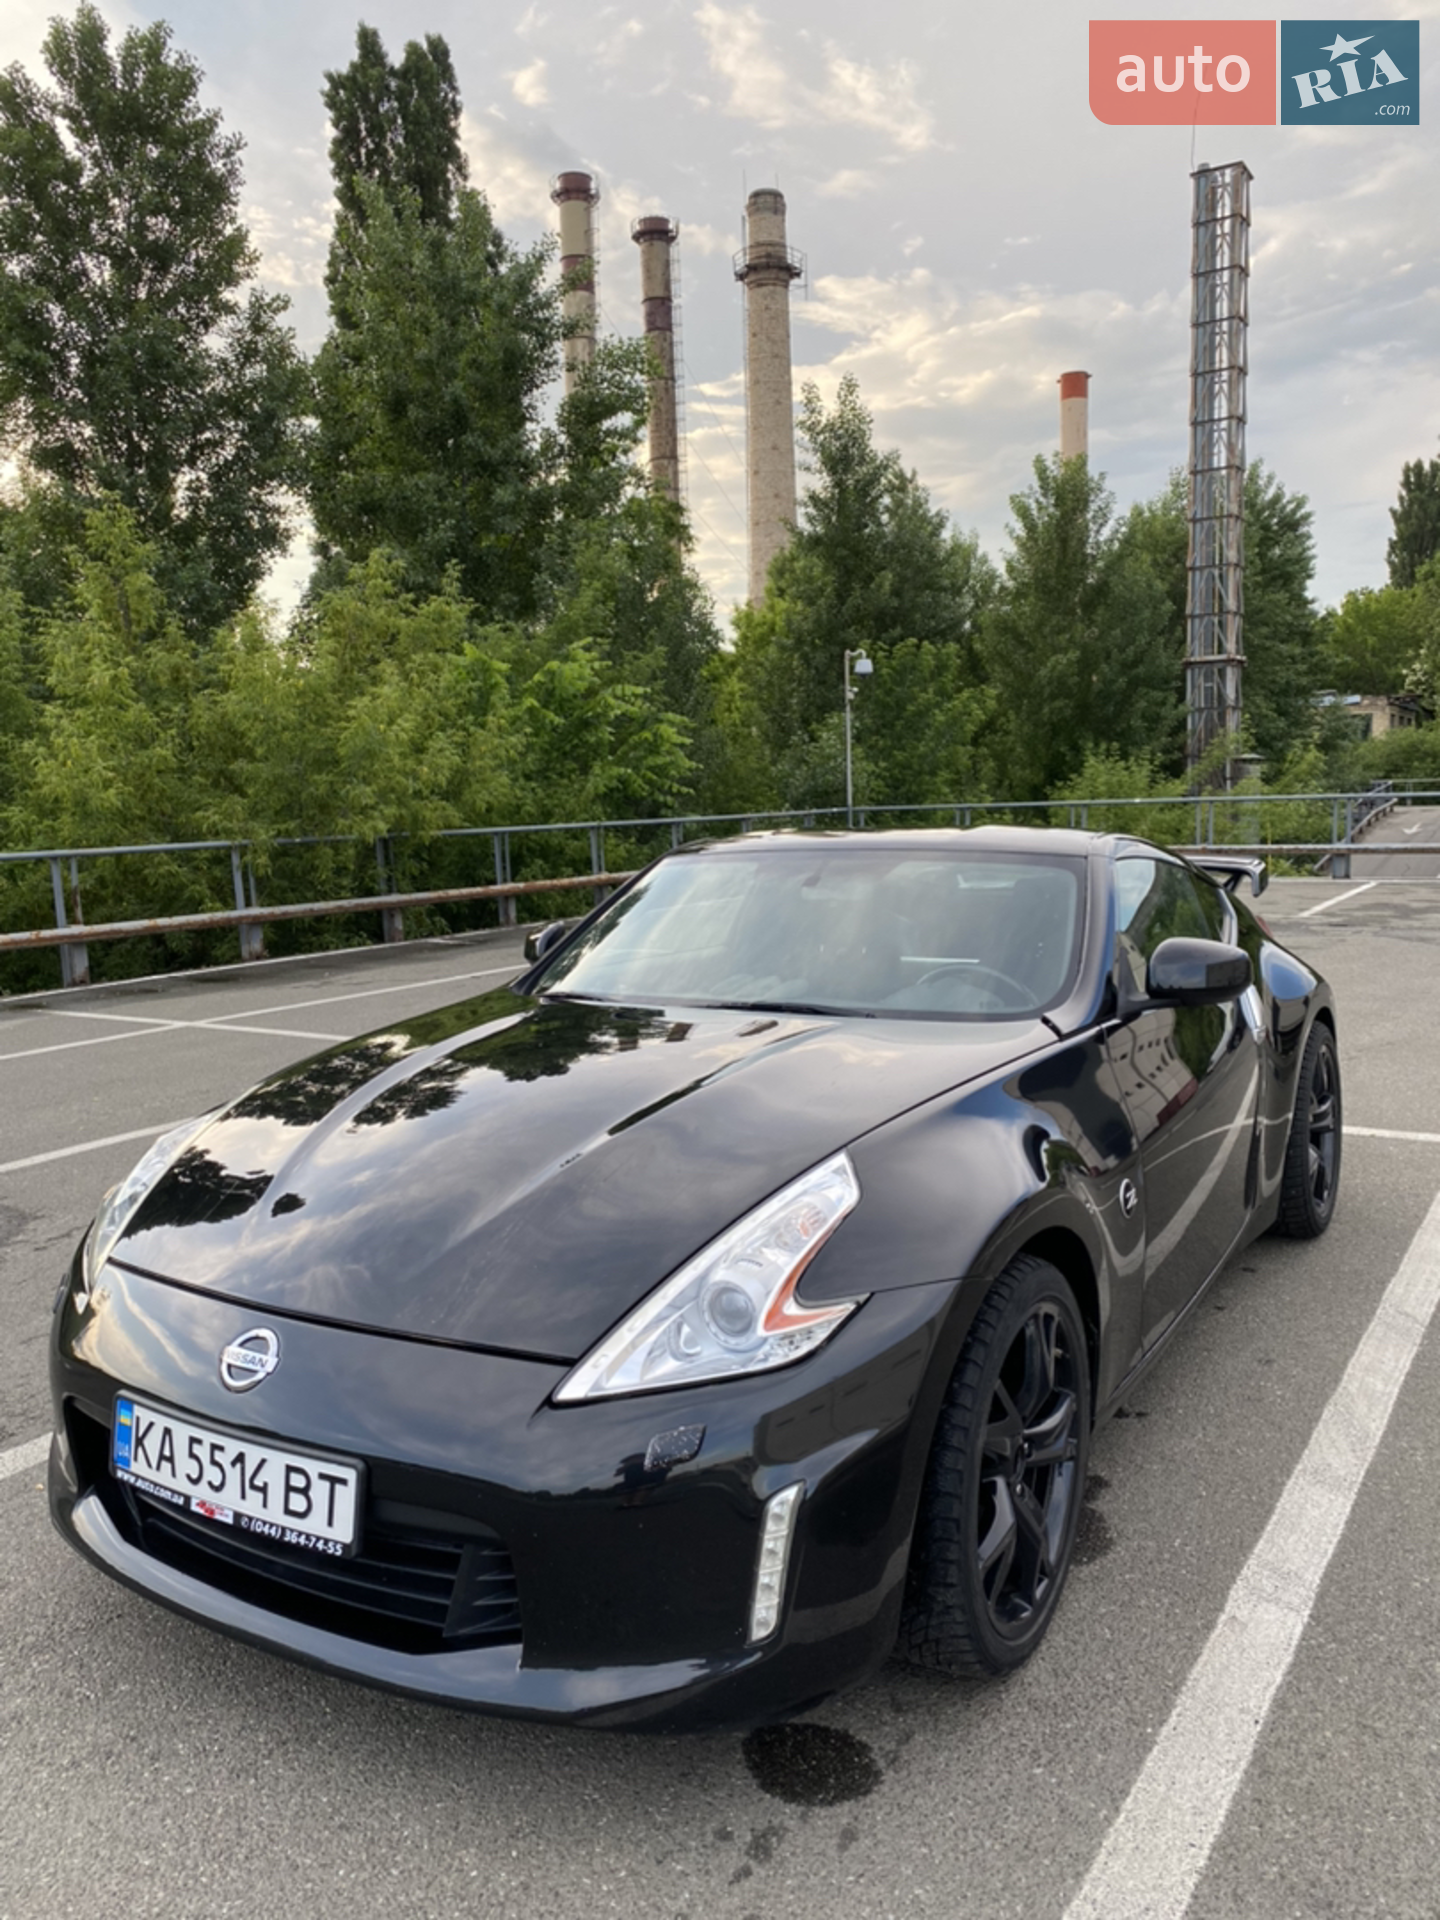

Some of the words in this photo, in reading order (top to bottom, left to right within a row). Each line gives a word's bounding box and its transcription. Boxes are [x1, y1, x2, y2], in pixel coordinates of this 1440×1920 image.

[226, 1348, 270, 1369] NISSAN
[133, 1414, 177, 1479] KA
[185, 1435, 270, 1510] 5514
[283, 1463, 349, 1529] BT
[250, 1517, 282, 1540] (044)
[284, 1528, 343, 1556] 364-74-55
